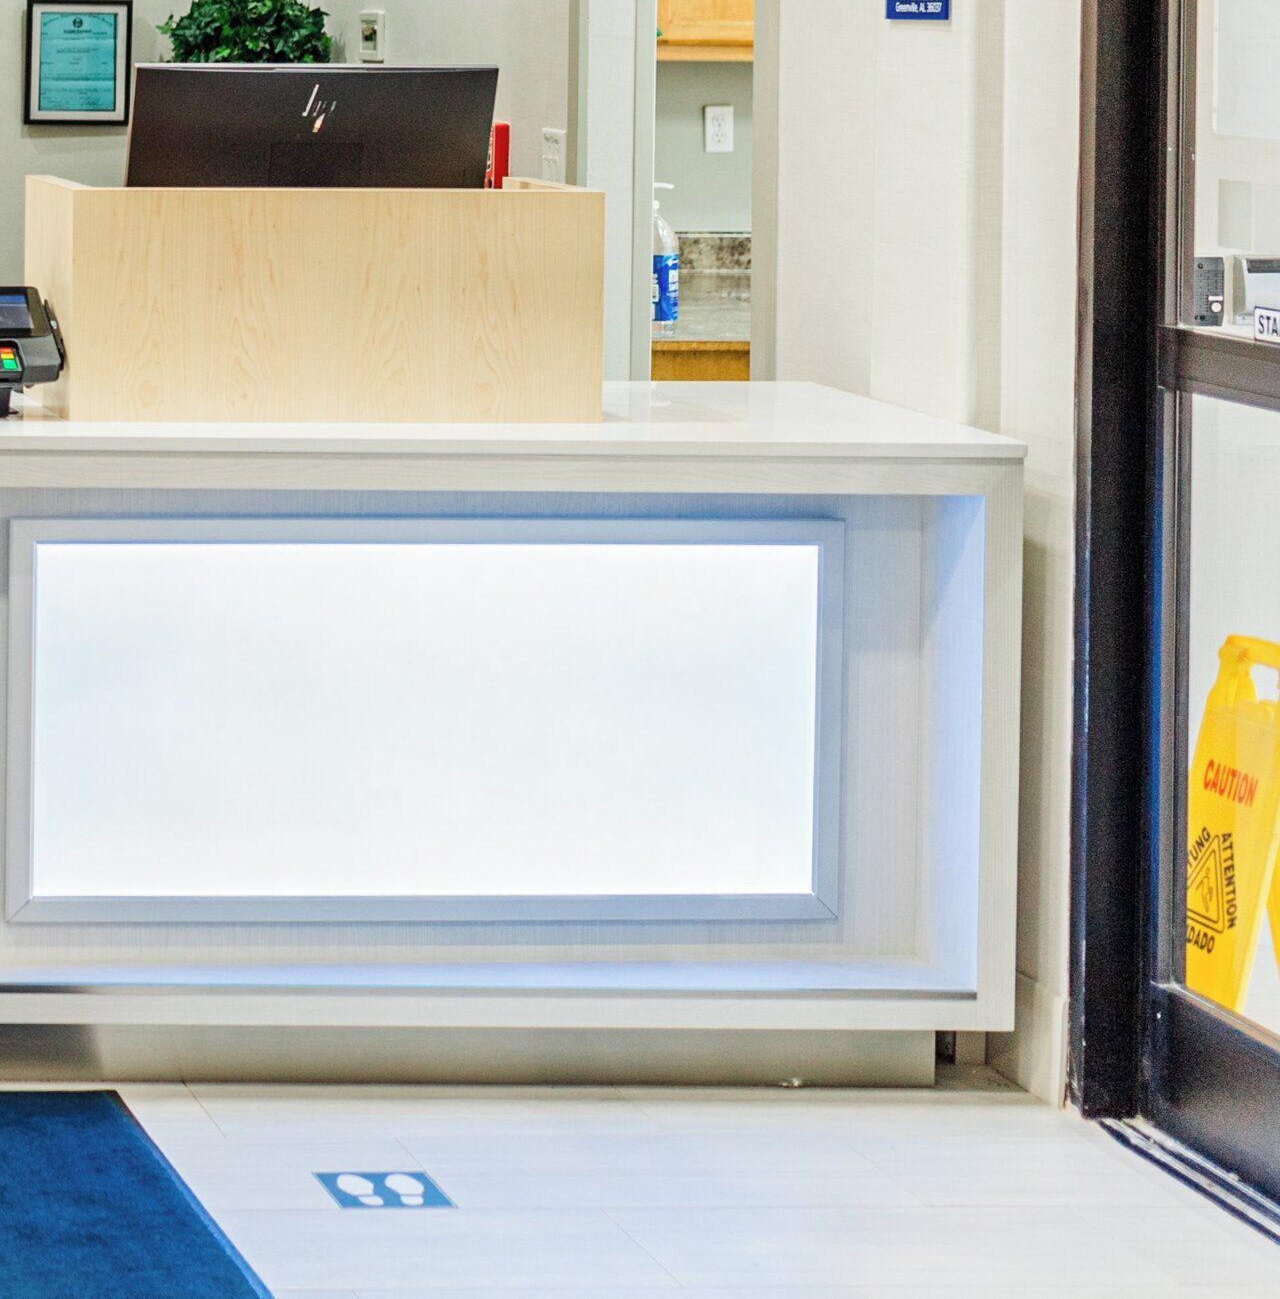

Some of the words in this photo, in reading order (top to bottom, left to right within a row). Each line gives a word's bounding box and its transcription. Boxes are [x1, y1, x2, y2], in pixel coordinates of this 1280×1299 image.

[1258, 314, 1280, 338] STA
[1203, 758, 1259, 808] CAUTION
[1221, 832, 1238, 930] ATTENTION
